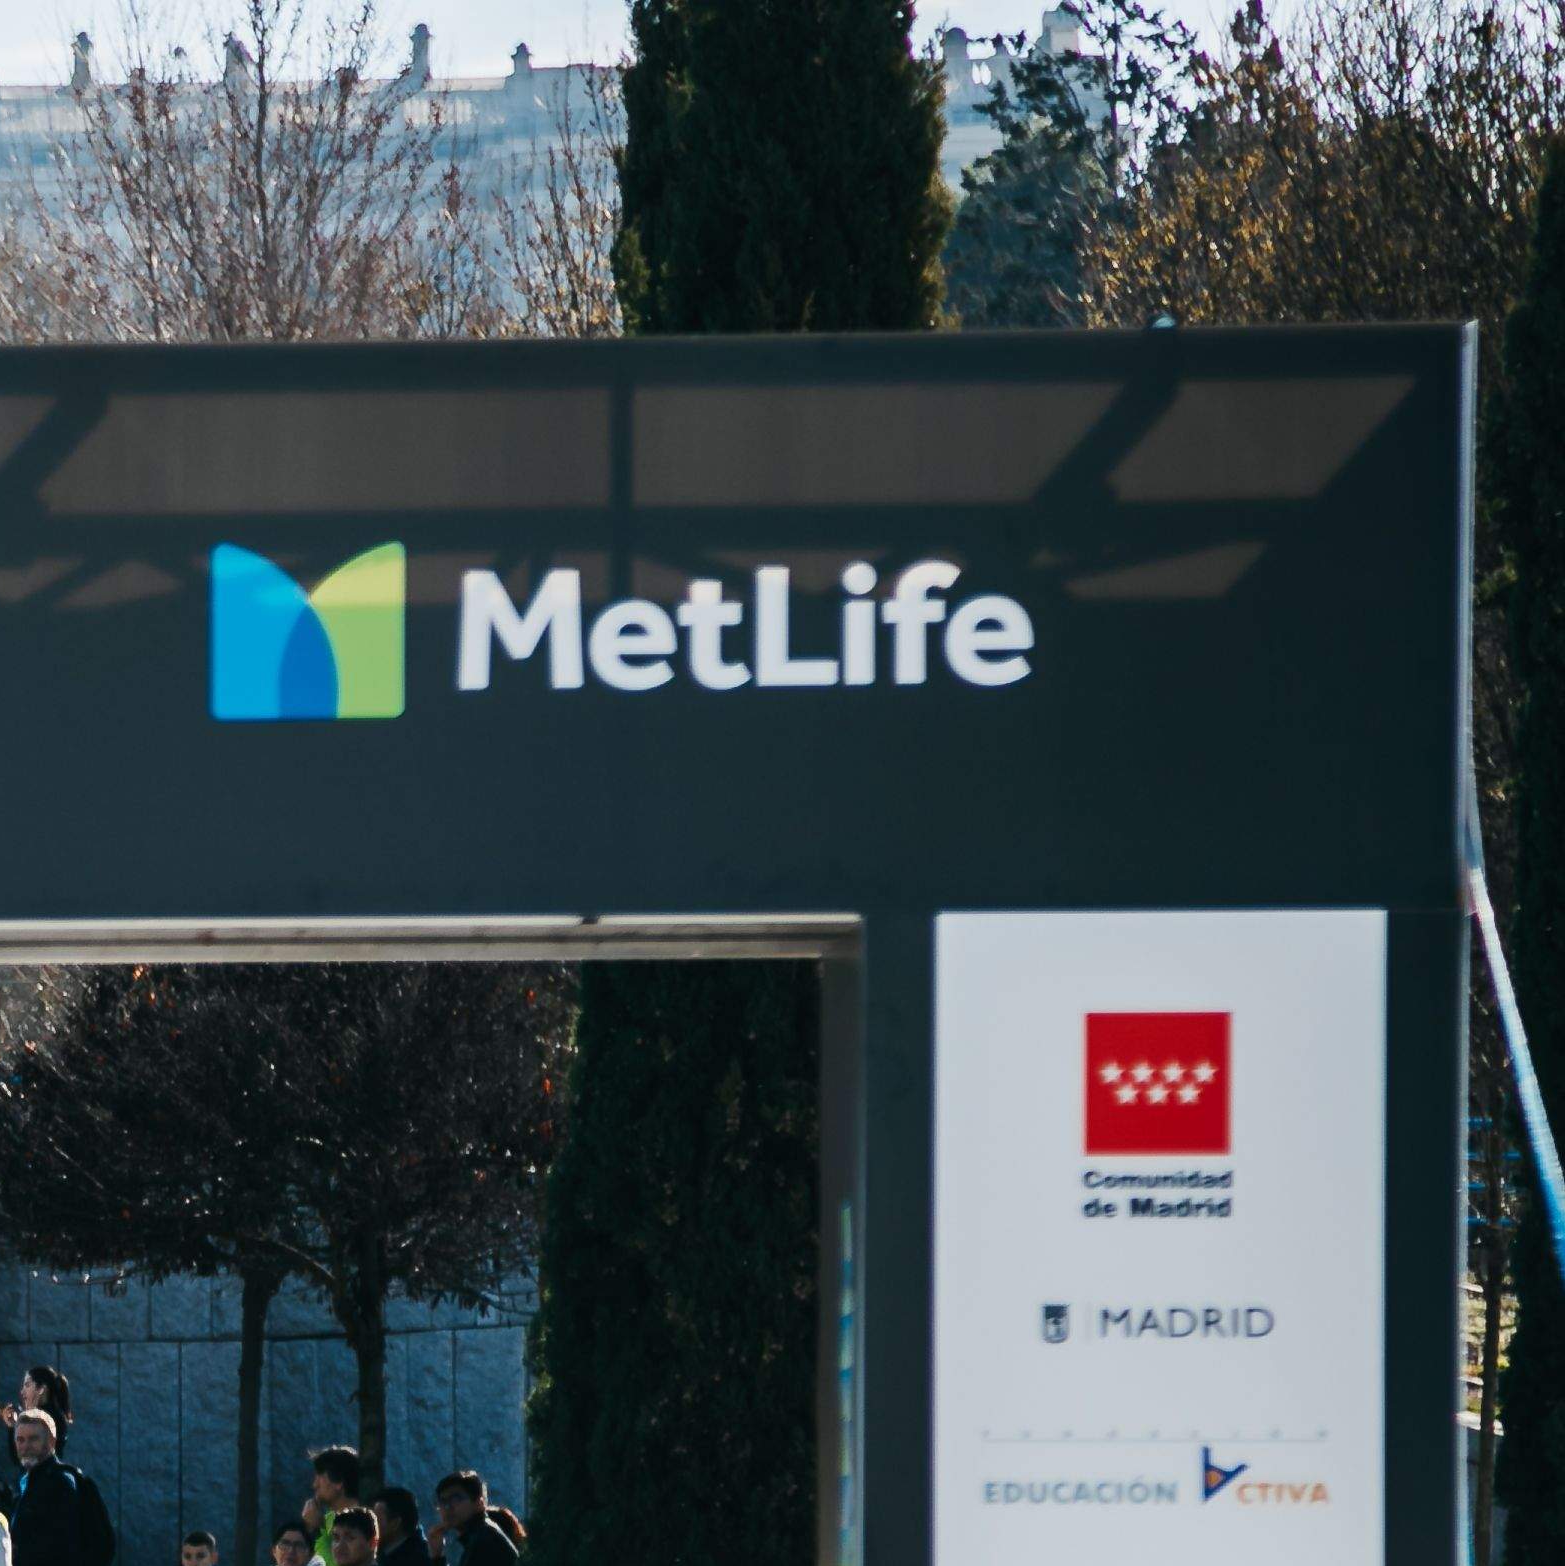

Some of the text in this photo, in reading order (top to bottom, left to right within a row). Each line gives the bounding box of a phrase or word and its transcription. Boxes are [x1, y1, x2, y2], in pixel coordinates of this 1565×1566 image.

[456, 558, 1036, 691] MetLife
[1082, 1169, 1234, 1189] Comunidad
[1083, 1197, 1233, 1217] de Madrid
[1099, 1306, 1276, 1339] MADRID
[983, 1473, 1178, 1505] EDUCACIÓN
